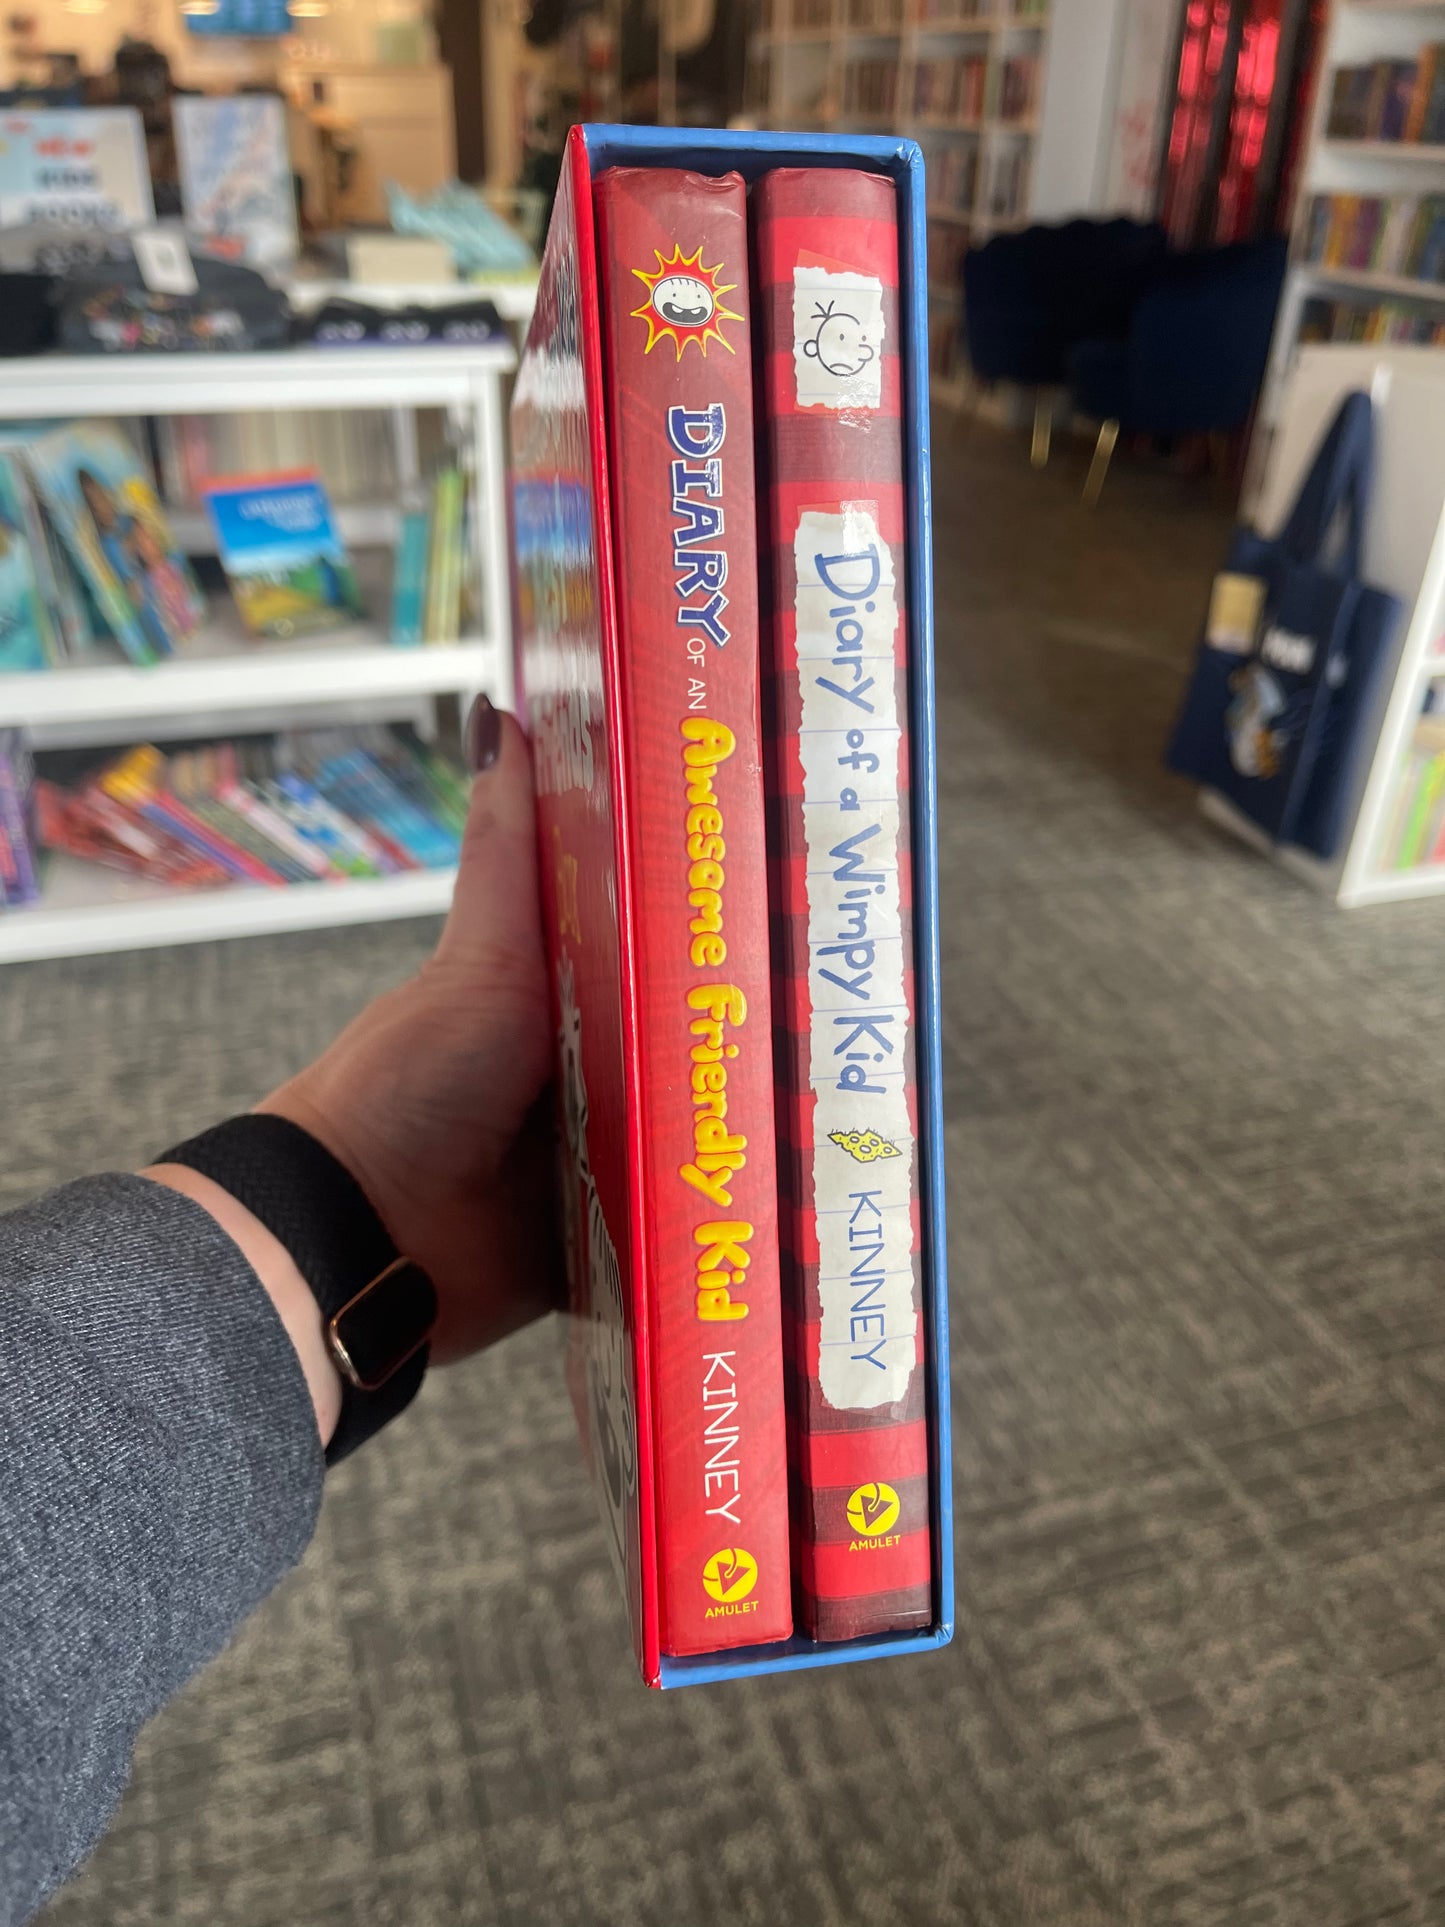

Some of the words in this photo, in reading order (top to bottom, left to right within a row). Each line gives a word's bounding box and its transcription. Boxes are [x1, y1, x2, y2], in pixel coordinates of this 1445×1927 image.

[667, 403, 731, 649] DIARY
[685, 637, 706, 668] OF
[814, 543, 881, 713] Diary
[687, 677, 707, 711] AN
[838, 729, 880, 773] of
[840, 788, 861, 811] a
[680, 717, 736, 967] Awesome
[816, 823, 886, 999] Wimpy
[679, 984, 748, 1206] Friendly
[833, 1014, 895, 1094] Kid
[694, 1222, 754, 1321] Kid
[848, 1189, 887, 1370] KINNEY
[702, 1350, 741, 1524] KINNEY
[849, 1534, 902, 1552] AMULET
[705, 1600, 759, 1619] AMULET
